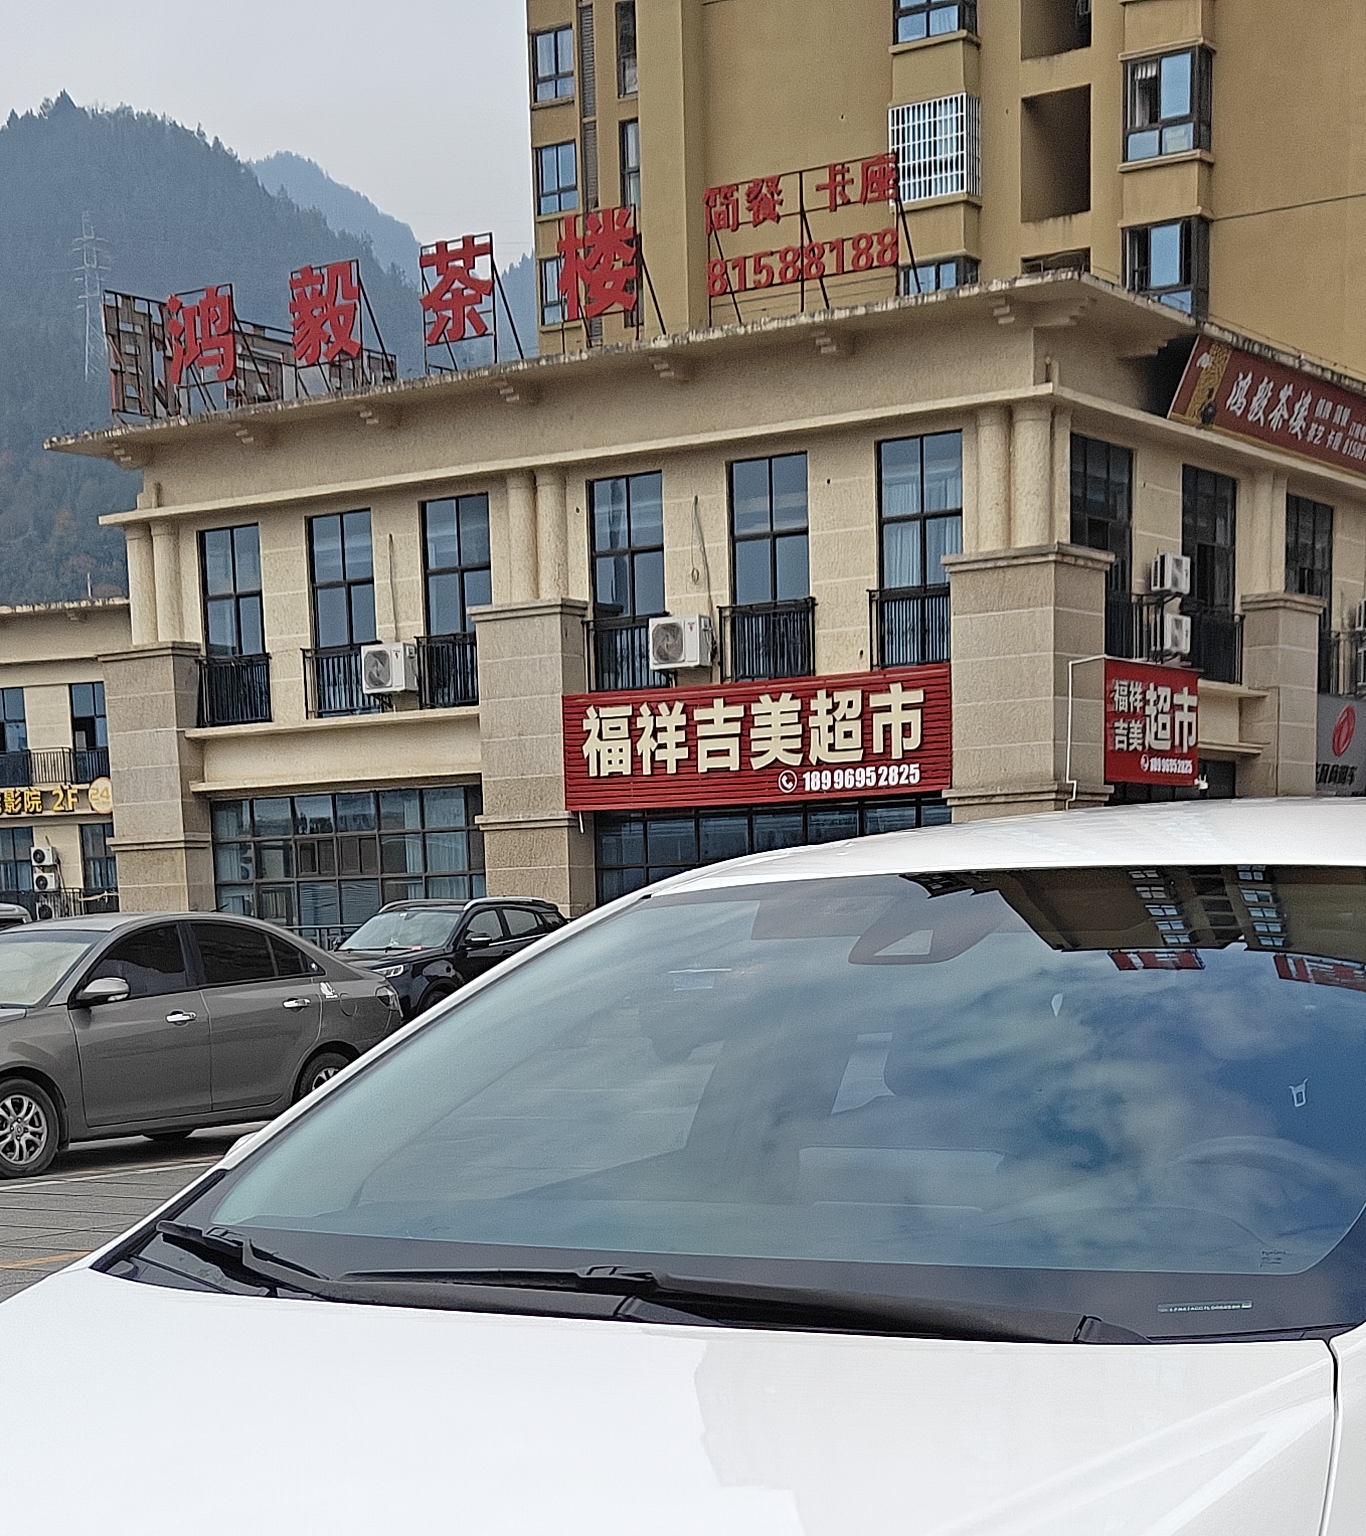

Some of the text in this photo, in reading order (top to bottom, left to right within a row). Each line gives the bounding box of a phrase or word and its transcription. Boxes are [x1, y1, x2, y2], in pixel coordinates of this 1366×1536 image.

[702, 153, 898, 236] 简餐 卡座
[166, 205, 637, 385] 鸿毅茶楼
[707, 229, 899, 297] 81588188
[582, 682, 925, 778] 福祥吉美超市
[1145, 682, 1198, 754] 超市
[51, 787, 78, 812] 2F
[802, 763, 921, 792] 18996952825
